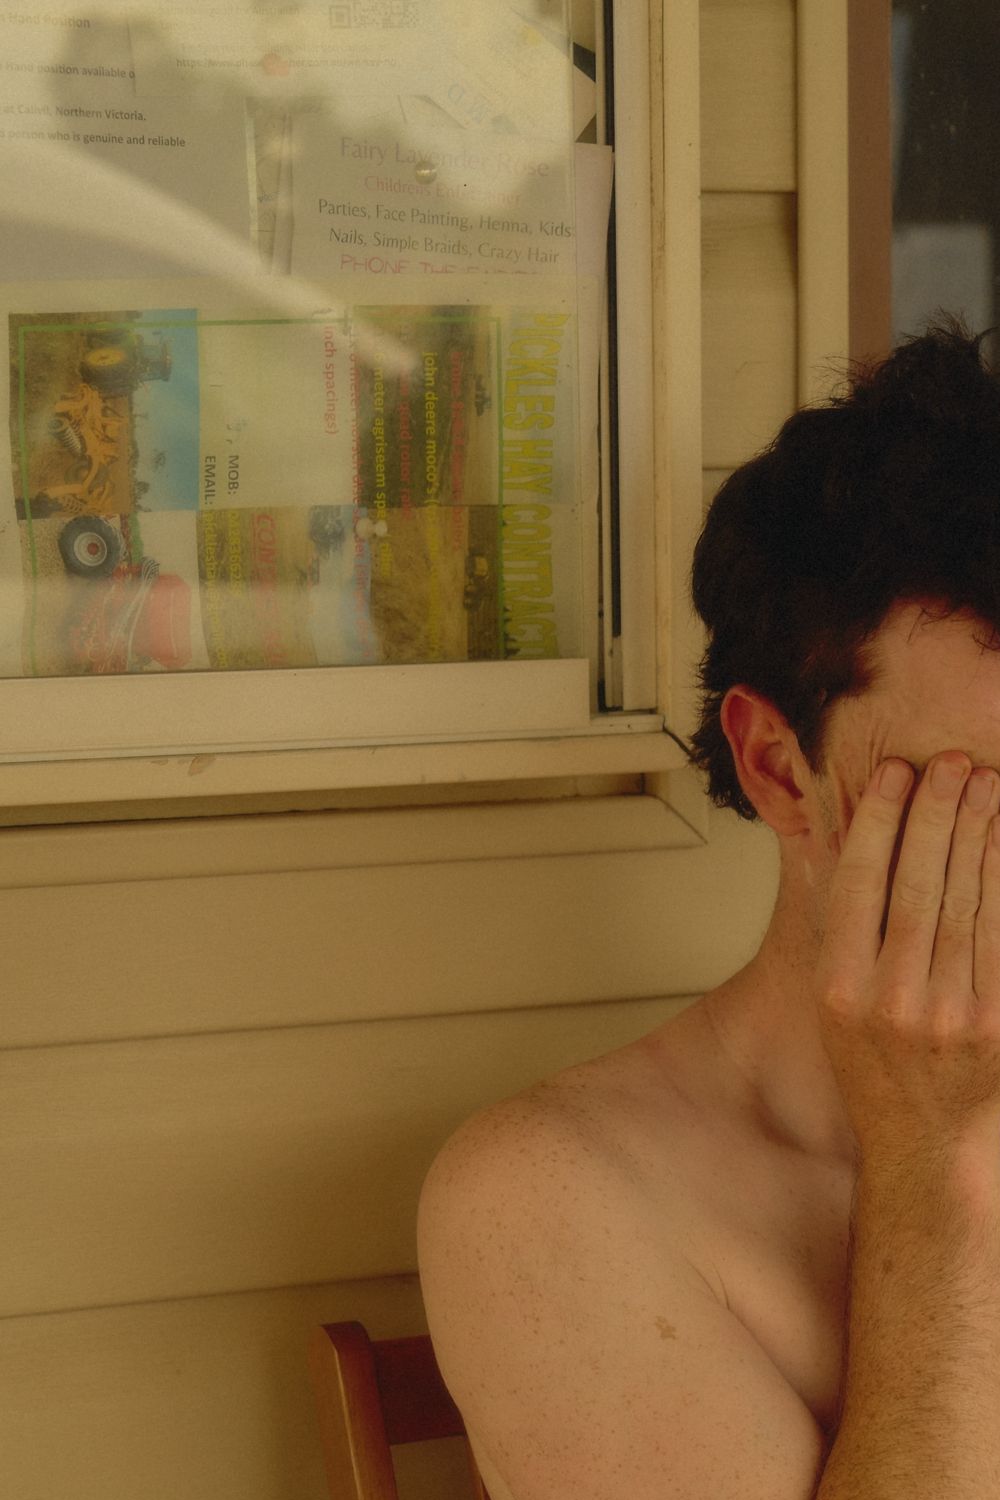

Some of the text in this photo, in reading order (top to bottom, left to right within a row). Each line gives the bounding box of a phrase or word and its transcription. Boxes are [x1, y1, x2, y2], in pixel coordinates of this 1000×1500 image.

[82, 66, 127, 79] available
[55, 106, 103, 119] Northern
[104, 109, 148, 121] Victoria.
[47, 131, 71, 141] who
[72, 132, 82, 142] is
[83, 133, 124, 145] genuine
[126, 135, 146, 145] and
[147, 136, 187, 148] reliable
[340, 136, 387, 166] Fairy
[318, 198, 372, 220] Parties,
[376, 204, 407, 222] Face
[411, 208, 474, 232] Painting,
[479, 215, 534, 235] Henna,
[329, 227, 561, 264] Nails, Simple Braids, Crazy Hair
[322, 326, 340, 436] inch spacings)
[422, 351, 439, 387] john
[503, 313, 571, 431] PICKLES
[374, 367, 386, 415] meter
[424, 390, 439, 435] deere
[372, 417, 388, 488] agriseem
[400, 445, 412, 484] rotor
[425, 440, 440, 495] moco's
[502, 439, 554, 495] HAY
[204, 455, 217, 505] EMAIL:
[227, 454, 240, 496] MOB:
